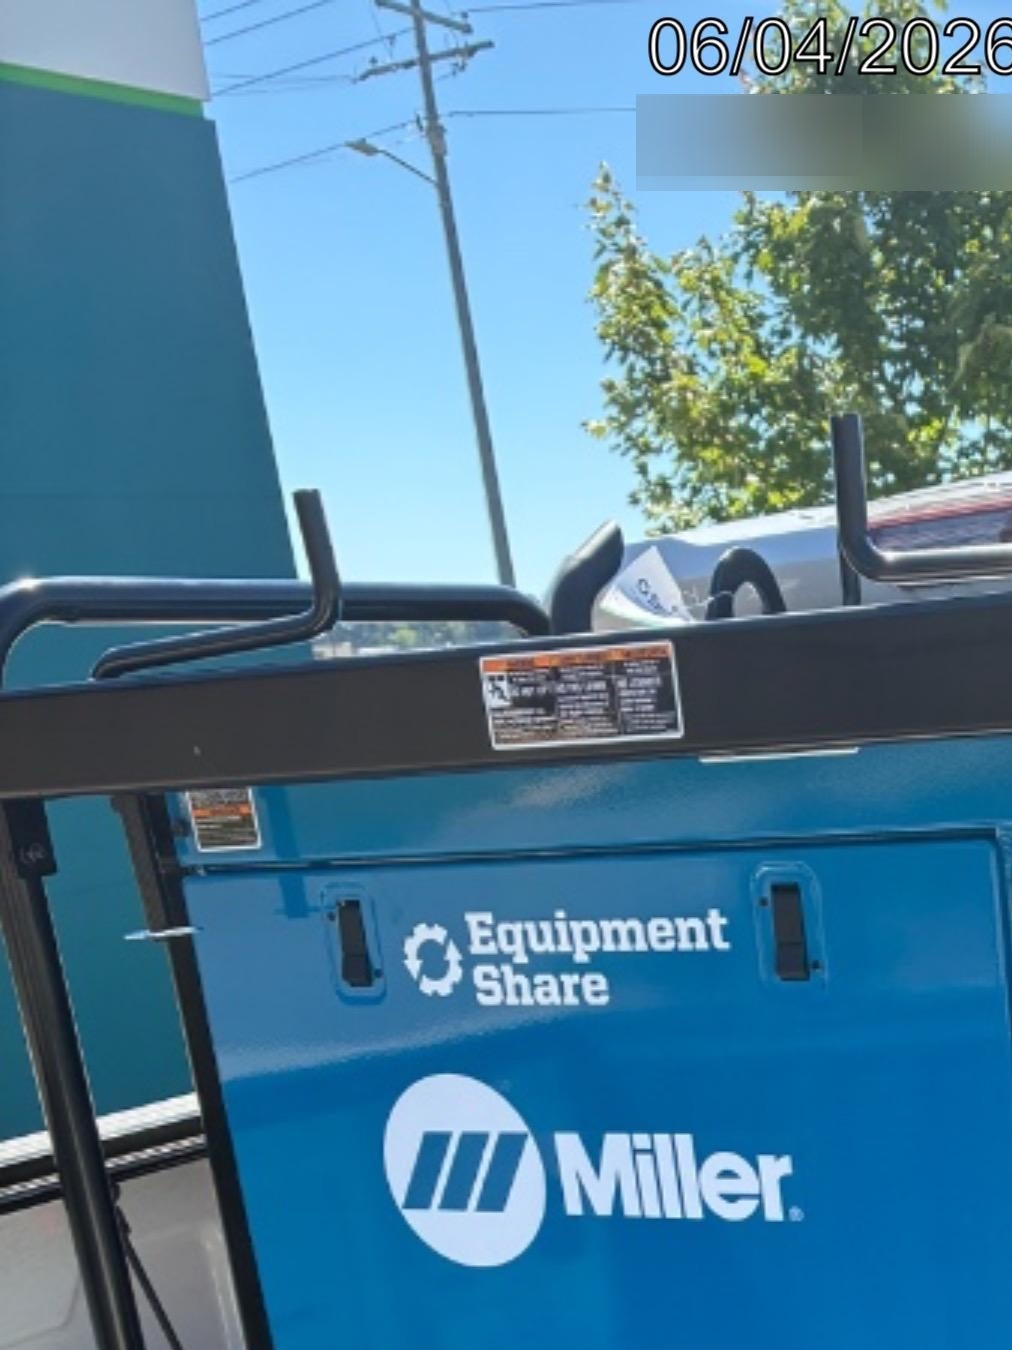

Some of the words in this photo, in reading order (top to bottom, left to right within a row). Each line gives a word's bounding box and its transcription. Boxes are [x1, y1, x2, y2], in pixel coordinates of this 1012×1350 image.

[464, 908, 731, 964] Equipment
[472, 964, 610, 1006] Share
[553, 1131, 793, 1222] Miller
